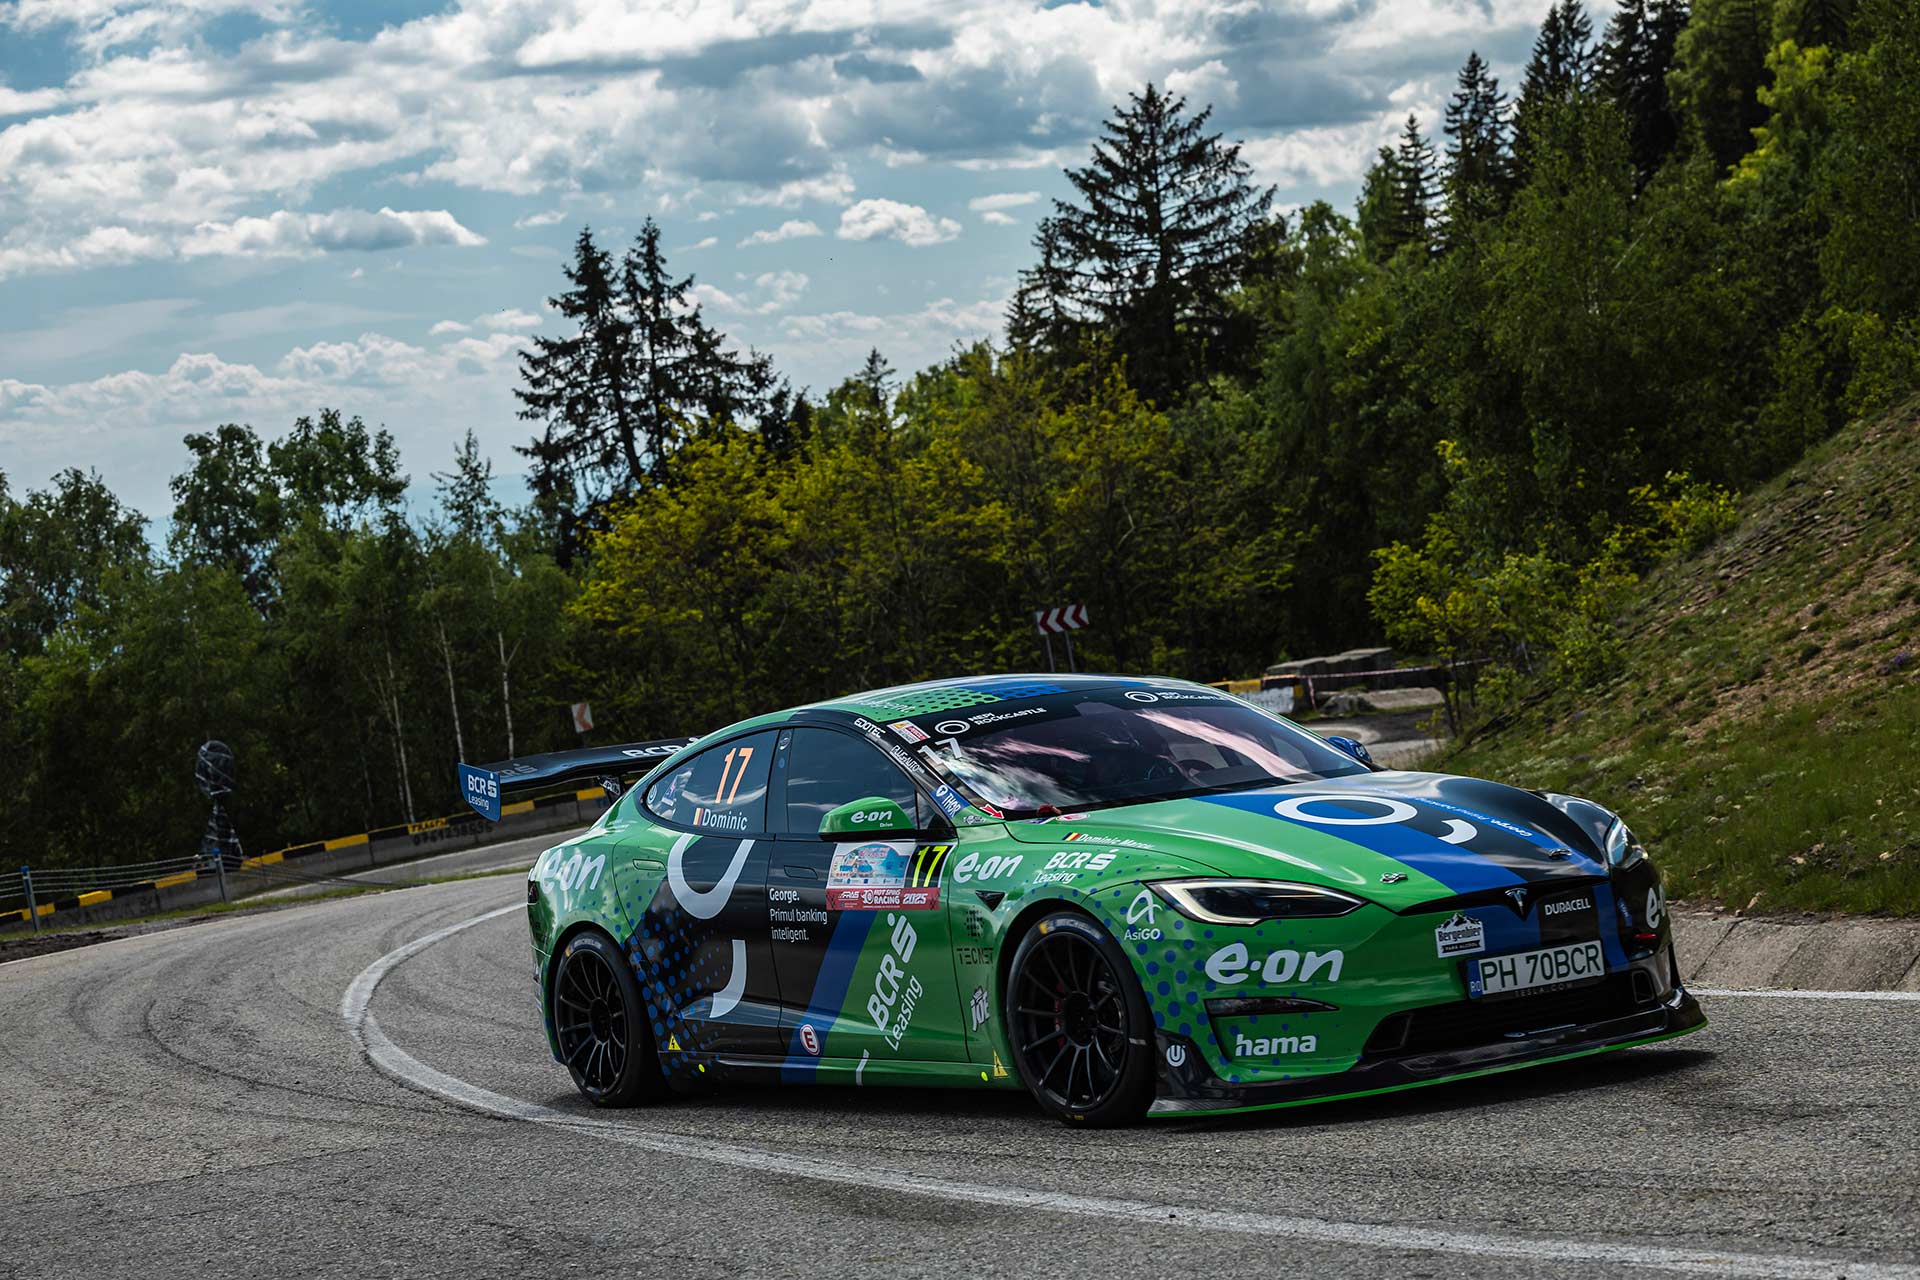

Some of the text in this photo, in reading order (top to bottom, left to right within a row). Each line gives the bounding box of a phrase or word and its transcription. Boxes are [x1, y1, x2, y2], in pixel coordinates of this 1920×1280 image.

[974, 707, 1047, 725] ROCKCASTLE
[917, 737, 962, 765] 17
[715, 747, 754, 804] 17
[468, 793, 489, 810] Leasing
[941, 792, 962, 817] THOR
[702, 809, 748, 831] Dominic
[1078, 834, 1121, 846] Dominic
[912, 845, 948, 888] 17
[1044, 852, 1092, 870] BCR
[1033, 870, 1077, 885] Leasing
[770, 887, 800, 903] George.
[874, 895, 900, 904] RACING
[903, 893, 928, 904] 2025
[1545, 898, 1591, 916] DURACELL
[770, 908, 828, 925] Primul banking
[771, 926, 809, 943] inteligent.
[1124, 928, 1161, 941] AsiGO
[1437, 926, 1481, 942] Bergenbier
[957, 947, 994, 965] TECNET
[1480, 944, 1601, 990] PH 70BCR
[867, 954, 905, 1032] BCR
[1470, 981, 1481, 992] RO
[885, 975, 923, 1051] Leasing
[803, 1031, 816, 1049] E
[1235, 1034, 1317, 1056] hama
